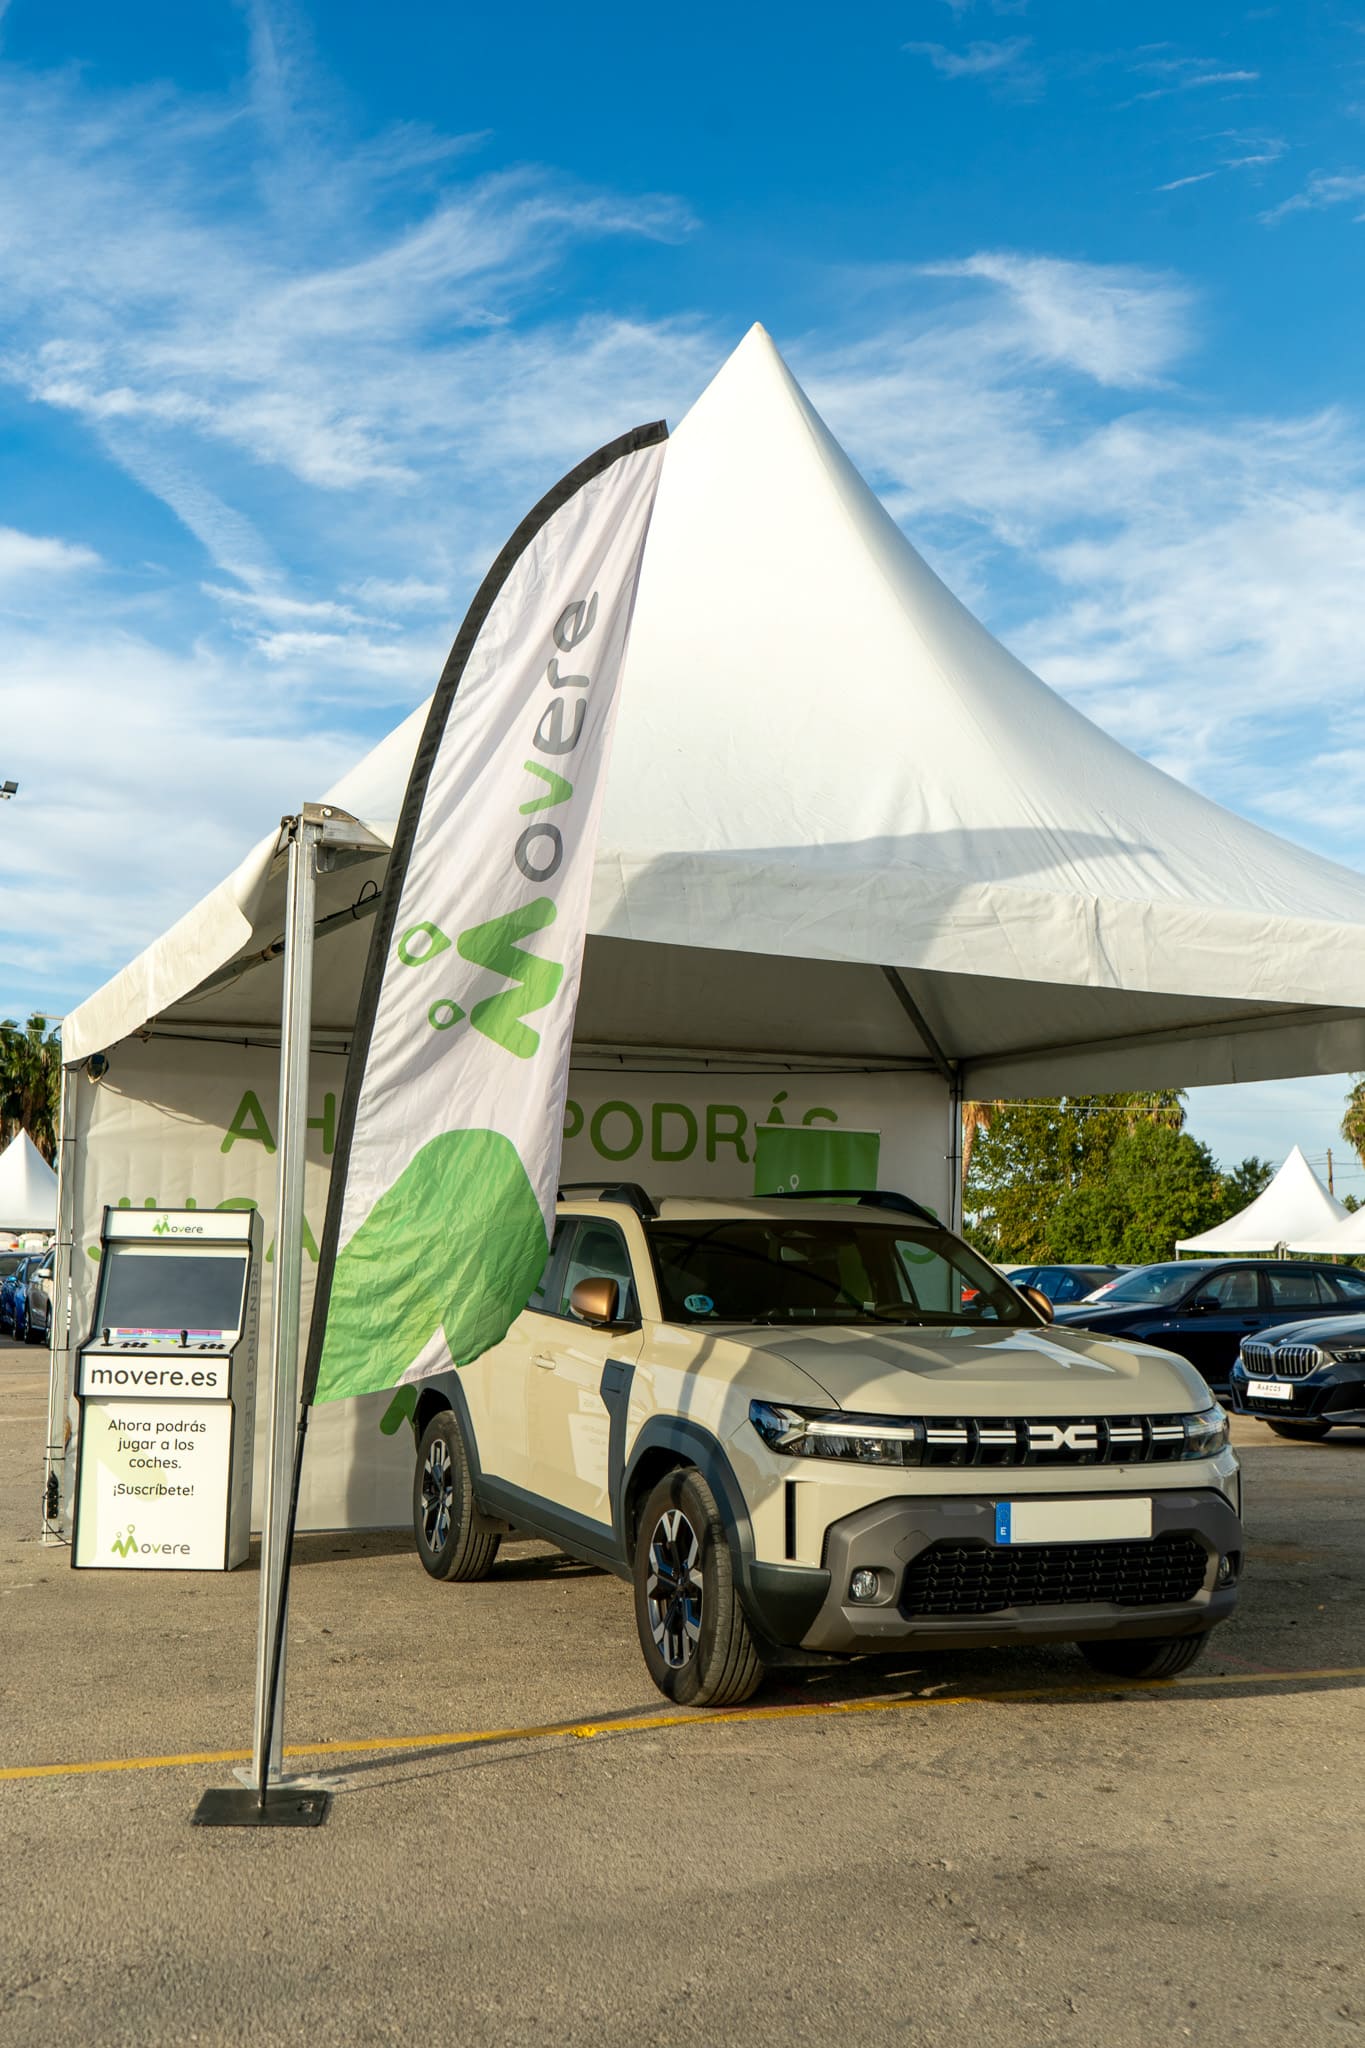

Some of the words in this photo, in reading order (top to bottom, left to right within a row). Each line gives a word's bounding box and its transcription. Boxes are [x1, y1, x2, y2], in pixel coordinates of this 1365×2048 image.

[457, 591, 599, 1060] Movere
[152, 1217, 204, 1236] Movere
[246, 1262, 260, 1374] RENTING
[90, 1368, 218, 1387] movere.es
[107, 1419, 151, 1432] Ahora
[155, 1420, 207, 1435] podrás
[117, 1437, 157, 1453] jugar
[160, 1441, 170, 1450] a
[174, 1438, 195, 1451] los
[128, 1456, 182, 1469] coches.
[113, 1483, 195, 1496] ¡Suscríbete!
[1000, 1526, 1007, 1536] E
[111, 1532, 191, 1558] Movere
